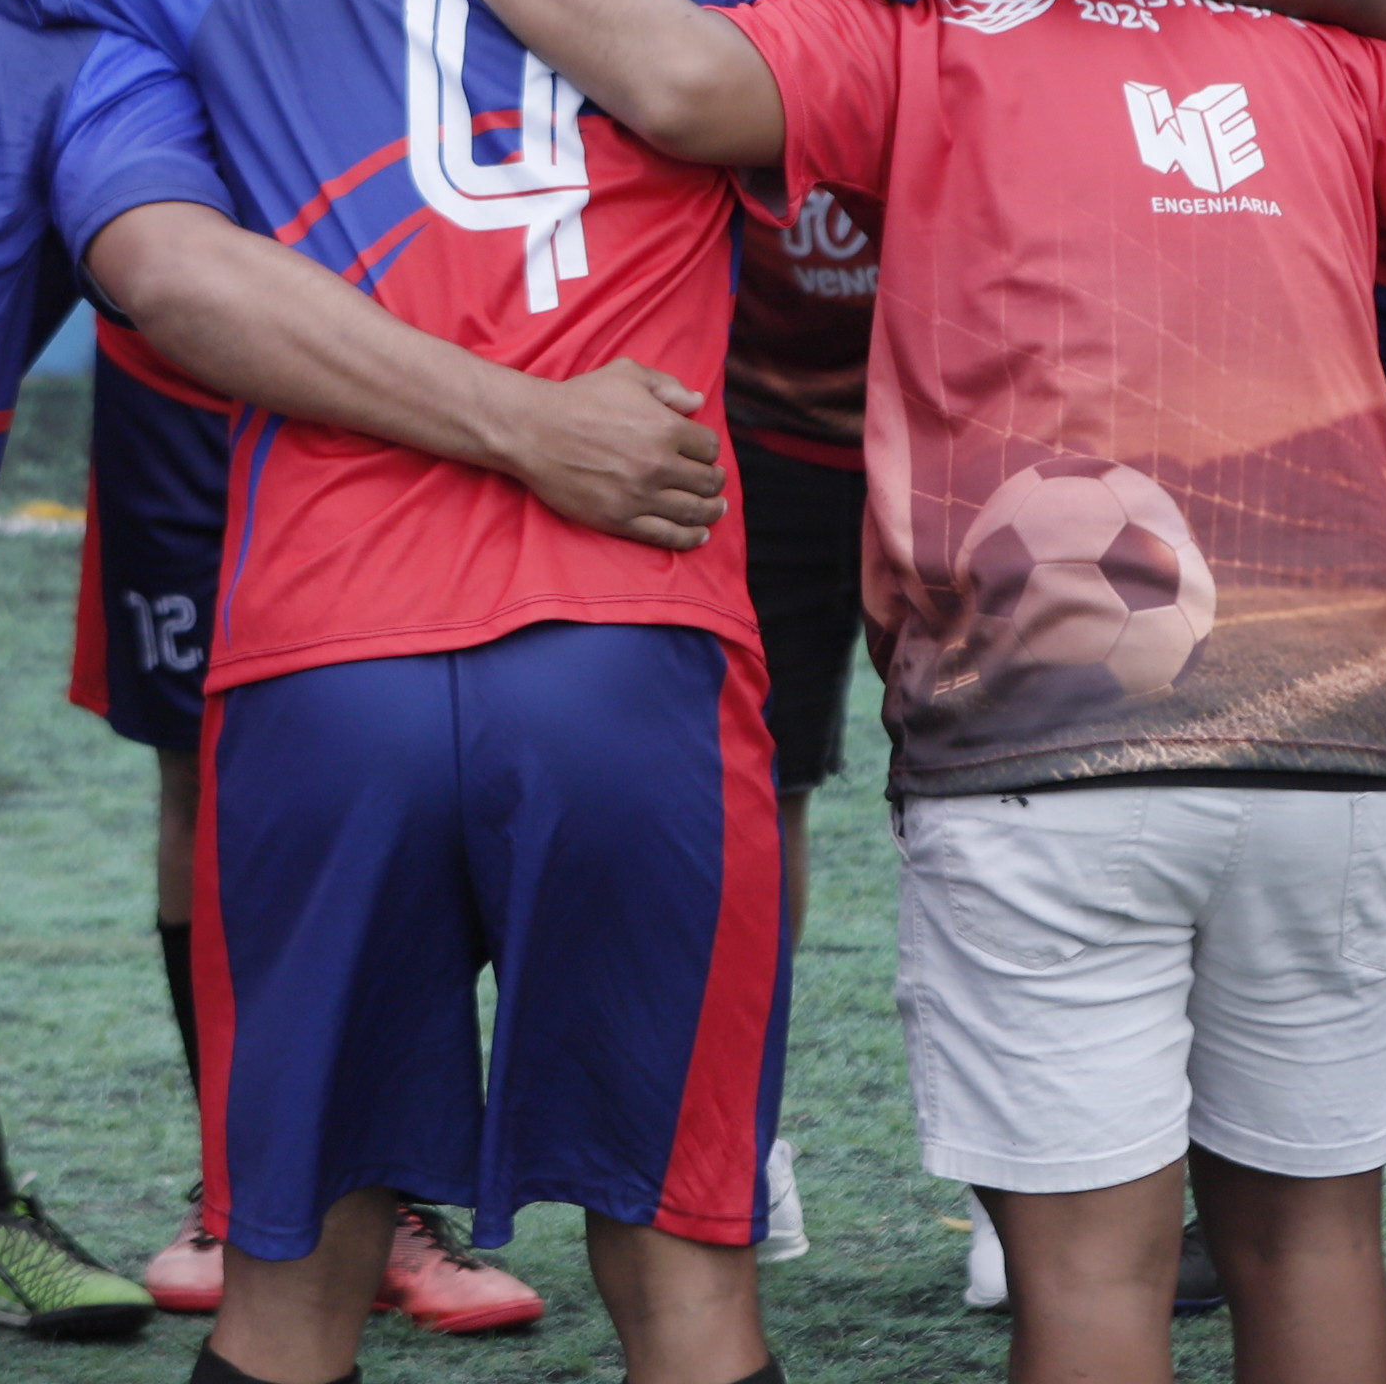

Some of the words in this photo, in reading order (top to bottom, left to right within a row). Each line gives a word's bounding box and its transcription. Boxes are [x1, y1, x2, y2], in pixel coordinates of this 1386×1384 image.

[1123, 80, 1265, 194] WE
[1151, 196, 1283, 217] ENGENHARIA
[127, 591, 204, 672] 12
